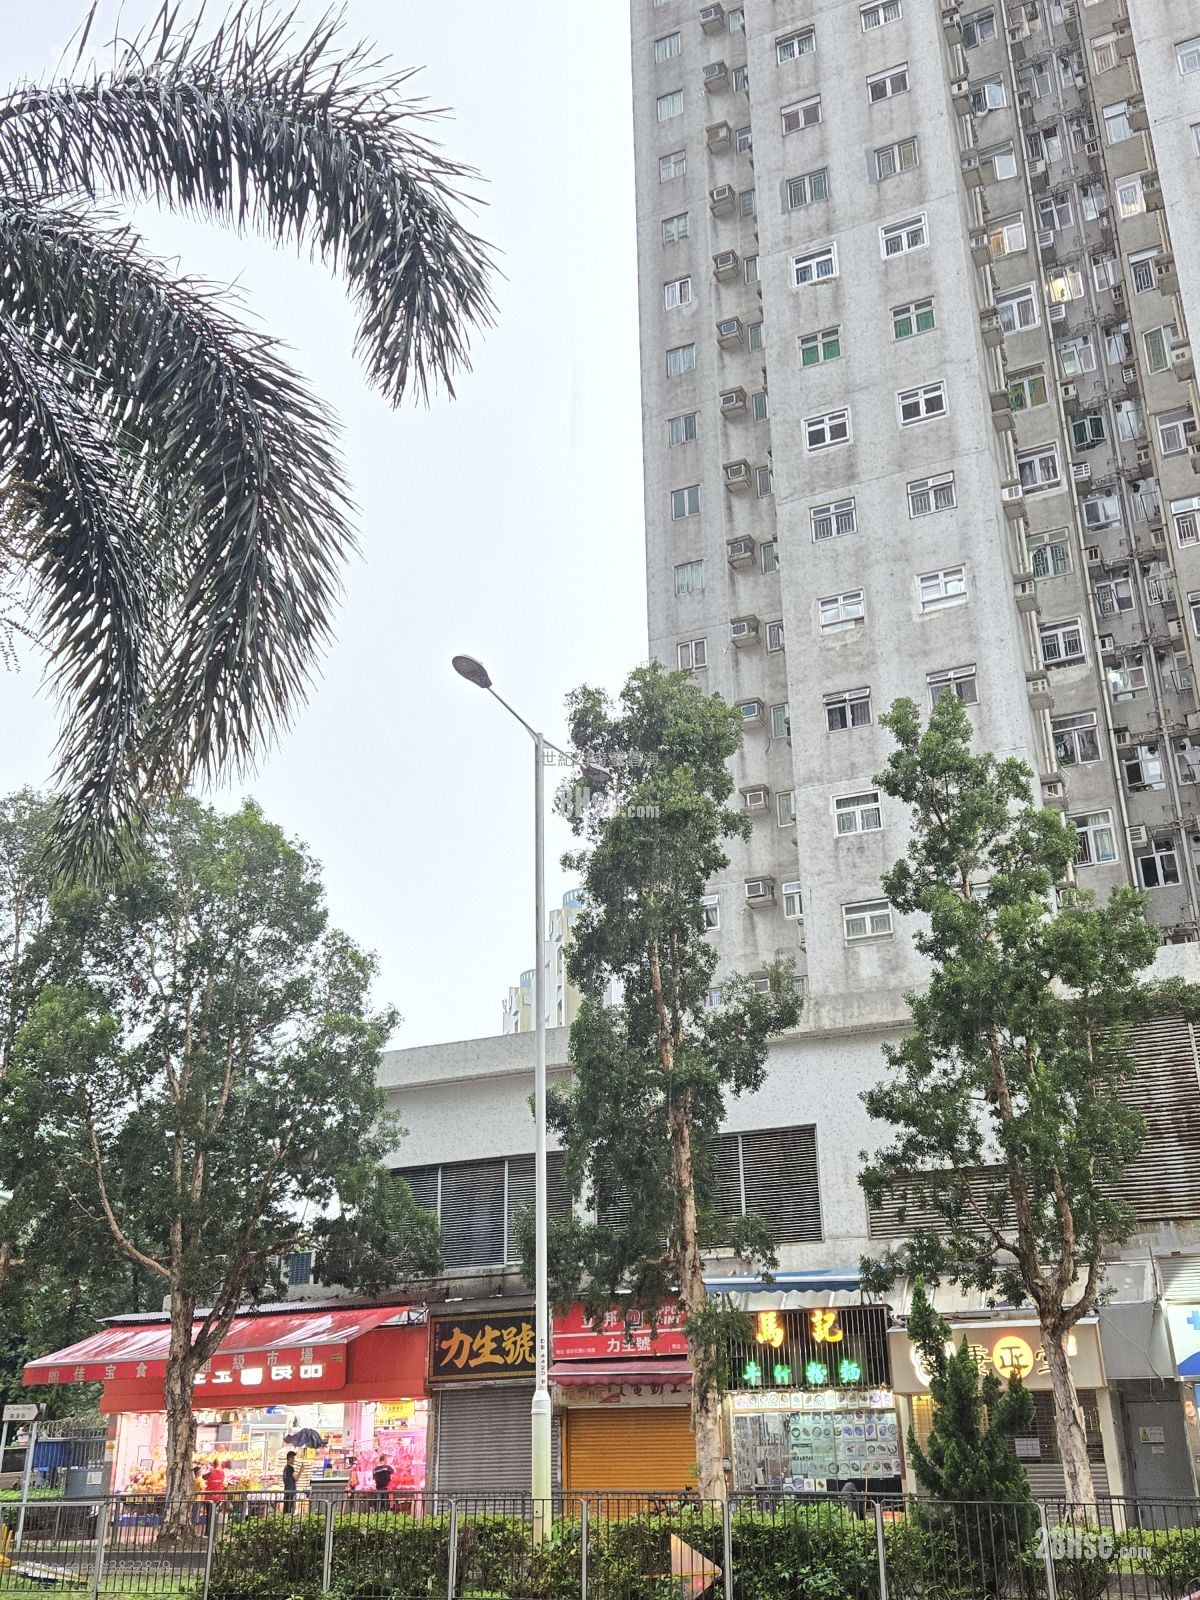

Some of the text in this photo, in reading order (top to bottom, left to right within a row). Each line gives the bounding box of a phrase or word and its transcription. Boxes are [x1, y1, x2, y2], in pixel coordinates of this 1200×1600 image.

[440, 1322, 537, 1368] 力生號
[607, 1337, 651, 1353] 力生號
[756, 1310, 843, 1348] 馬記
